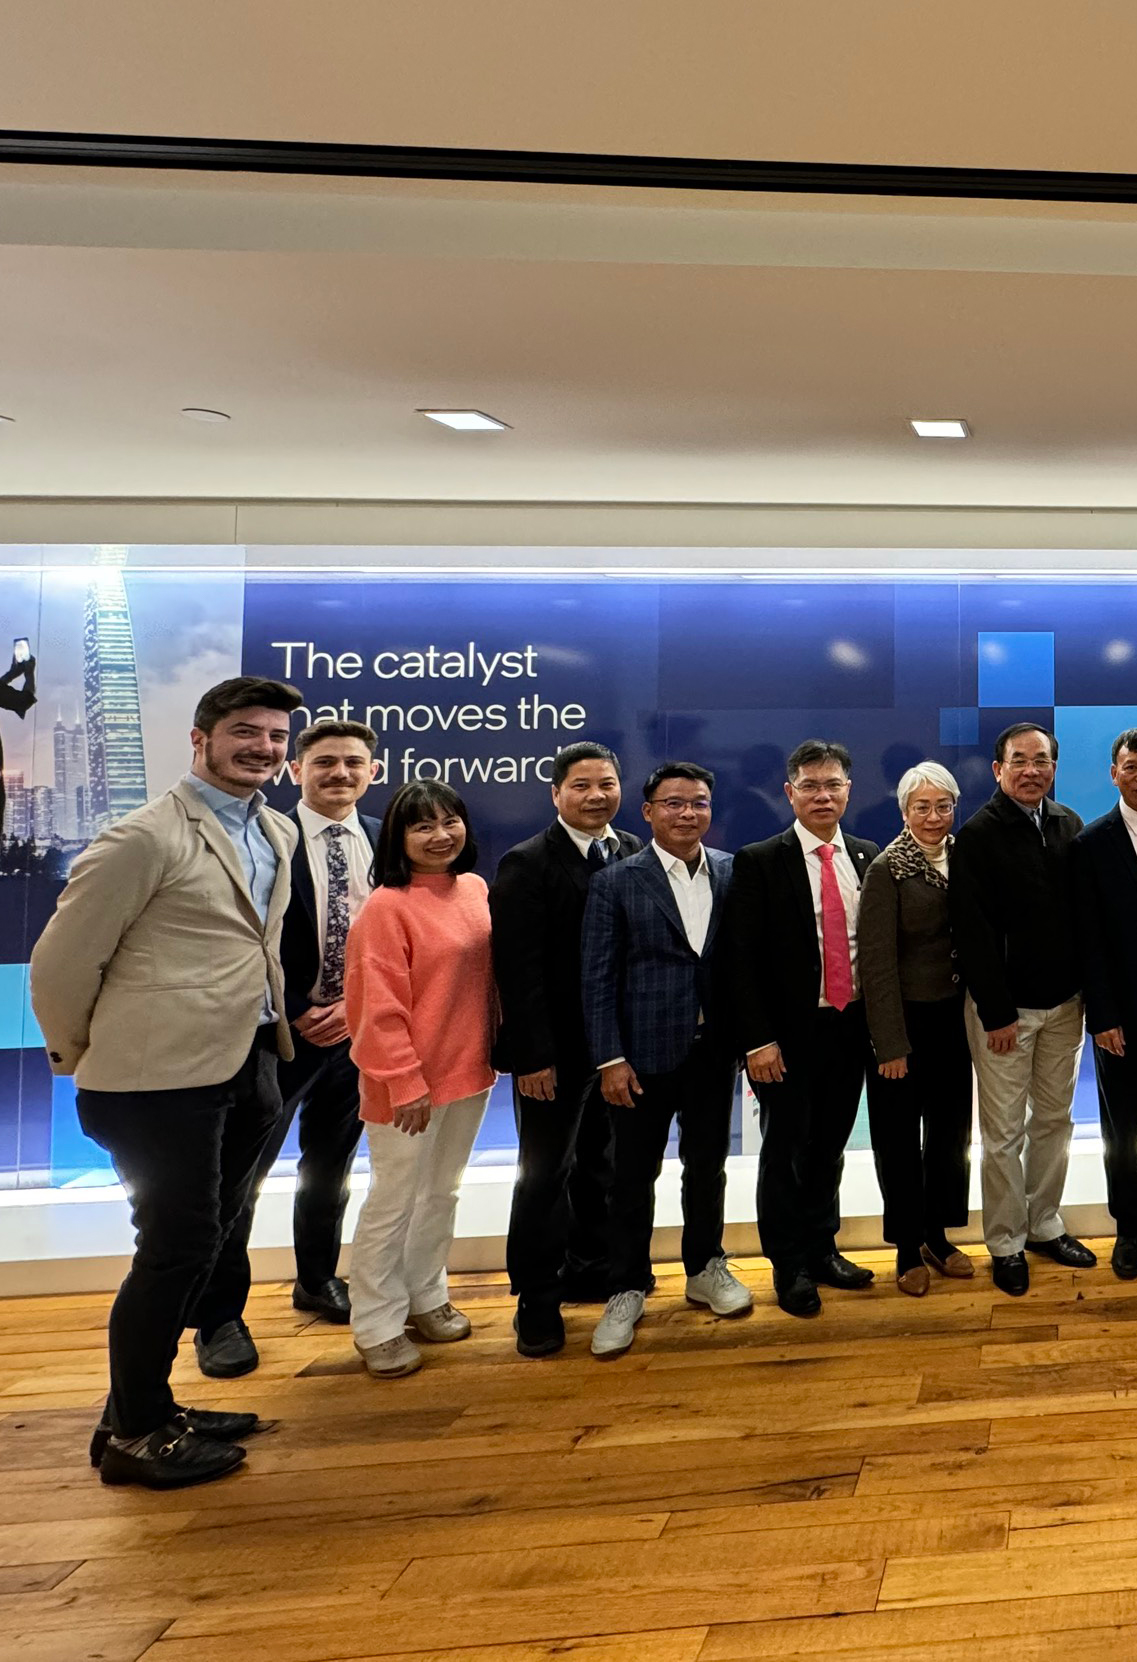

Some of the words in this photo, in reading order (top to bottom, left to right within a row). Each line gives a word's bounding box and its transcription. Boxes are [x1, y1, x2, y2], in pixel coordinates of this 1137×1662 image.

[271, 642, 363, 679] The
[373, 641, 538, 686] catalyst
[366, 704, 507, 731] moves
[517, 694, 586, 730] the
